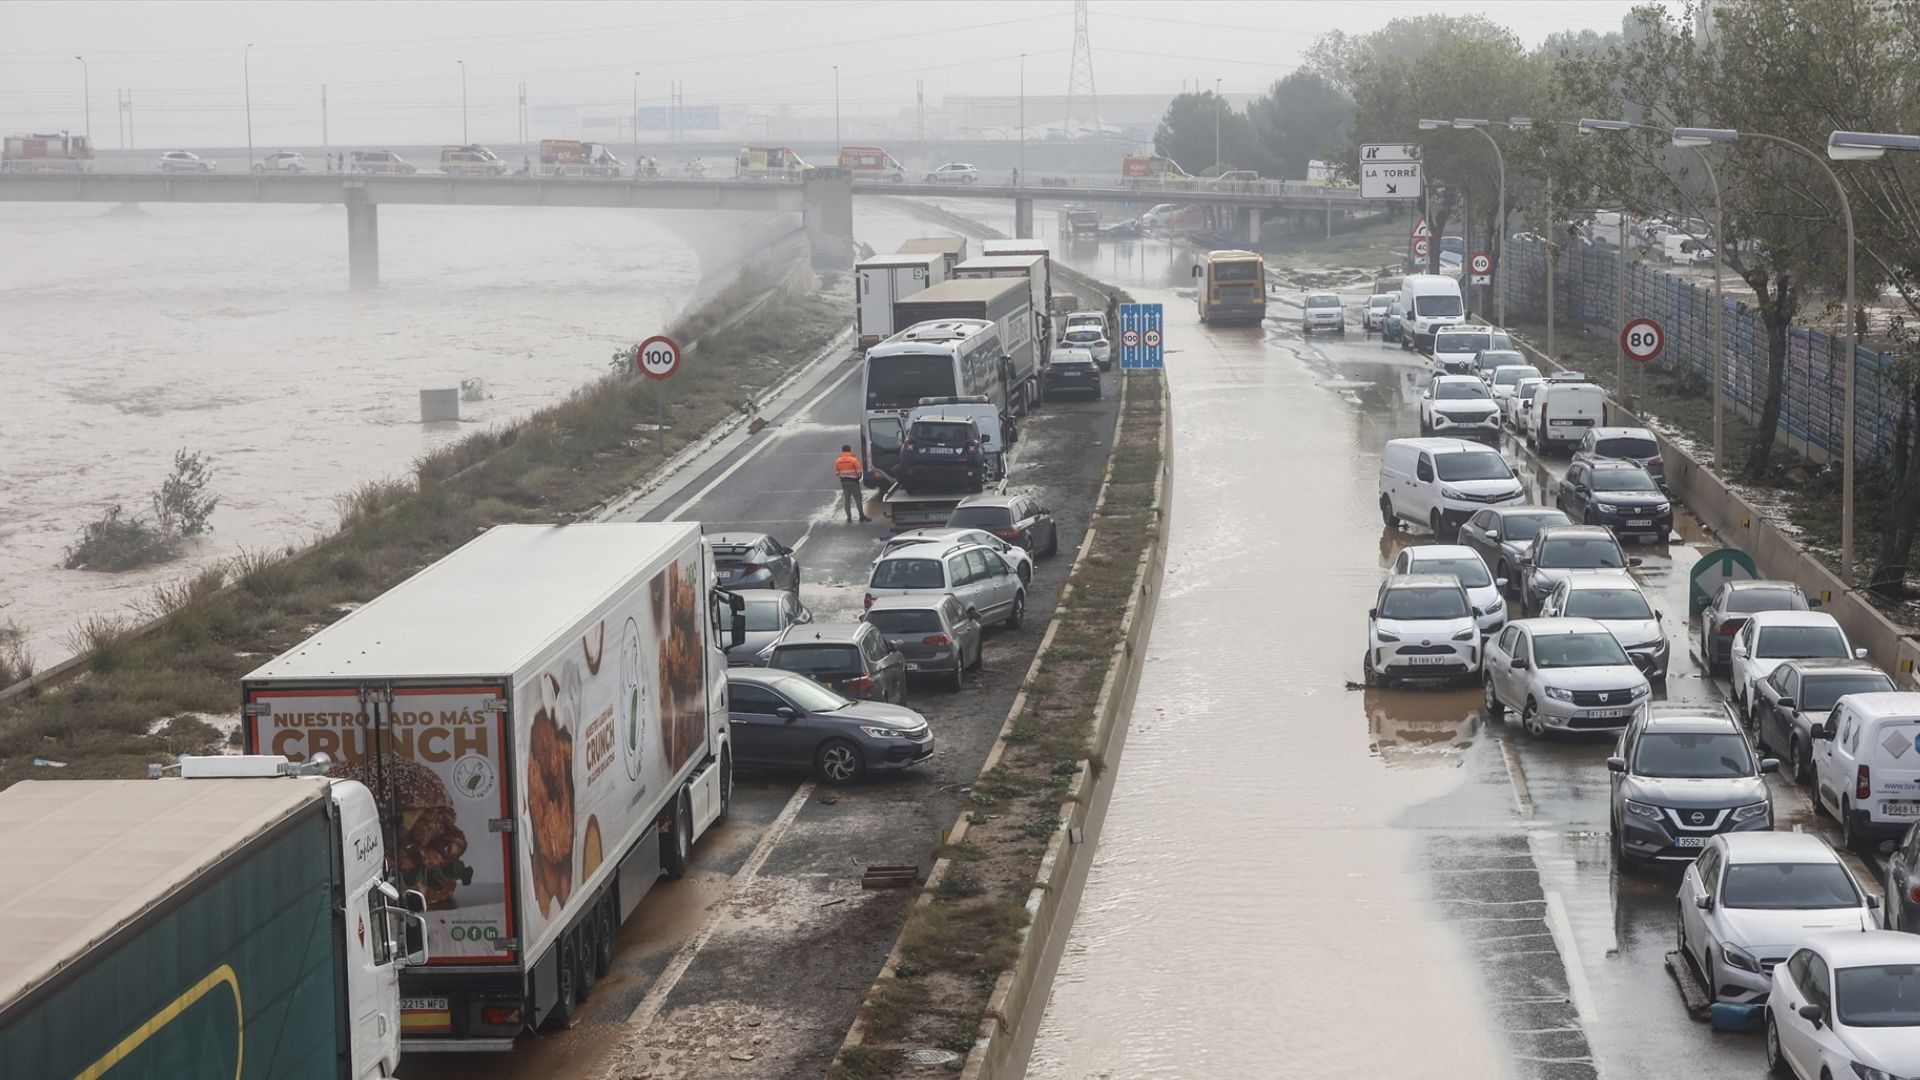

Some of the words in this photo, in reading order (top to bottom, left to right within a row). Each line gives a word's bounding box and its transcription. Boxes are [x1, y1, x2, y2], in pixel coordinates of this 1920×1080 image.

[1366, 170, 1377, 178] LA
[1383, 169, 1417, 177] TORRE
[1475, 260, 1487, 268] 60
[915, 268, 923, 279] 9
[1631, 333, 1655, 347] 80
[645, 350, 673, 365] 100
[273, 711, 370, 728] NUESTRO
[440, 706, 486, 726] MÁS
[271, 727, 489, 765] CRUNCH
[586, 718, 615, 771] CRUNCH
[1888, 805, 1908, 814] 9968
[1681, 838, 1700, 846] 3552
[402, 1000, 425, 1009] 2215
[427, 1000, 445, 1009] MFD
